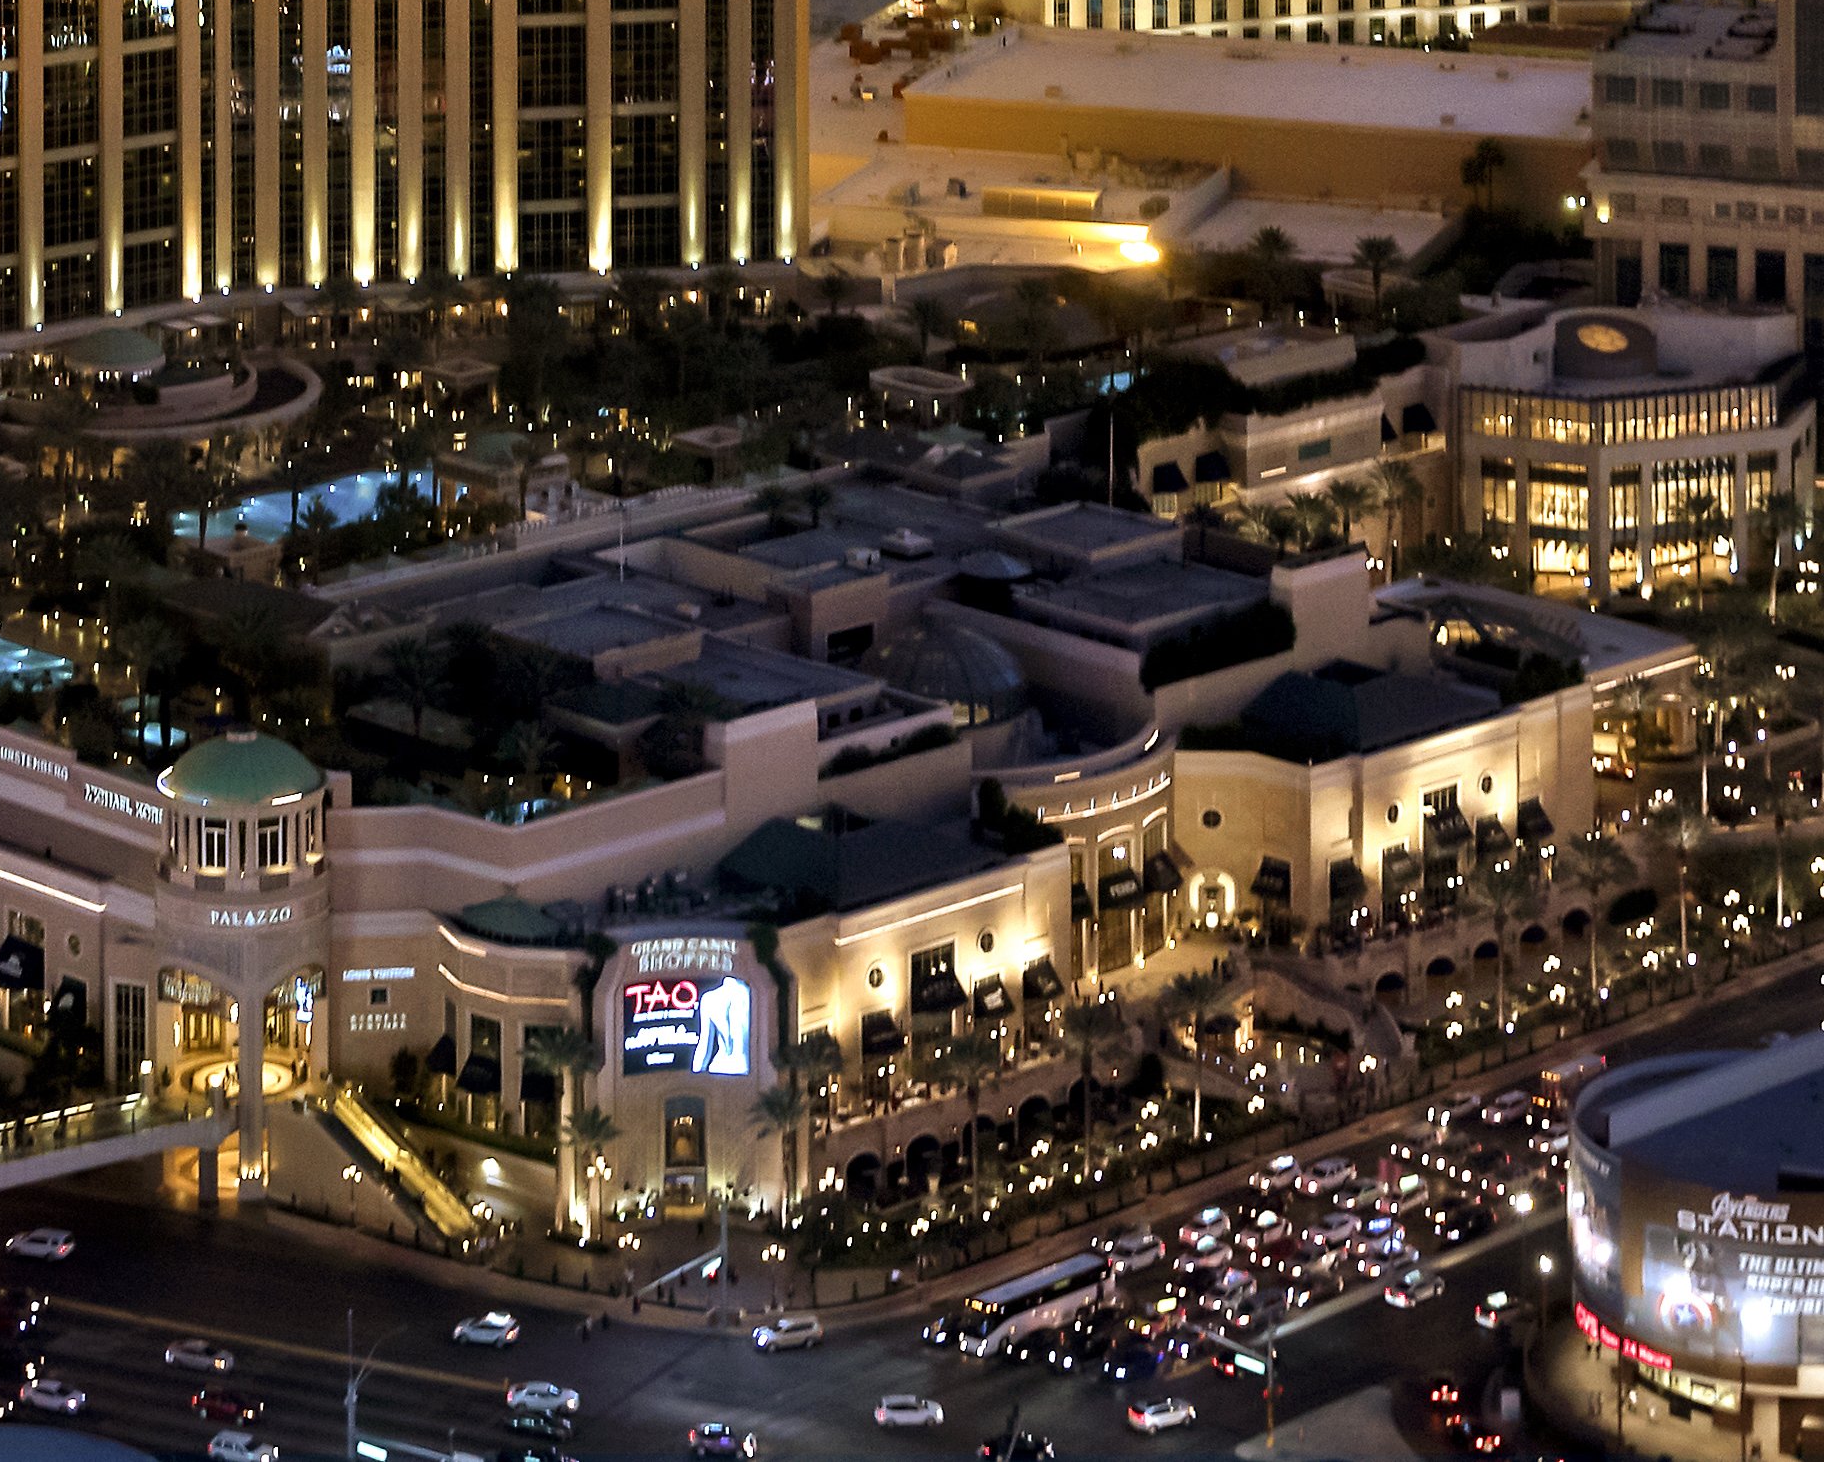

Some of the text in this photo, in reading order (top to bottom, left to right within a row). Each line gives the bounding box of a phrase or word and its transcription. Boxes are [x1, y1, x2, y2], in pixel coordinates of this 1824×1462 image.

[210, 905, 292, 927] PALAZZO
[631, 938, 685, 956] GRAND
[638, 952, 734, 974] SHOPPES
[625, 980, 698, 1014] TAO
[1739, 1252, 1771, 1273] THE
